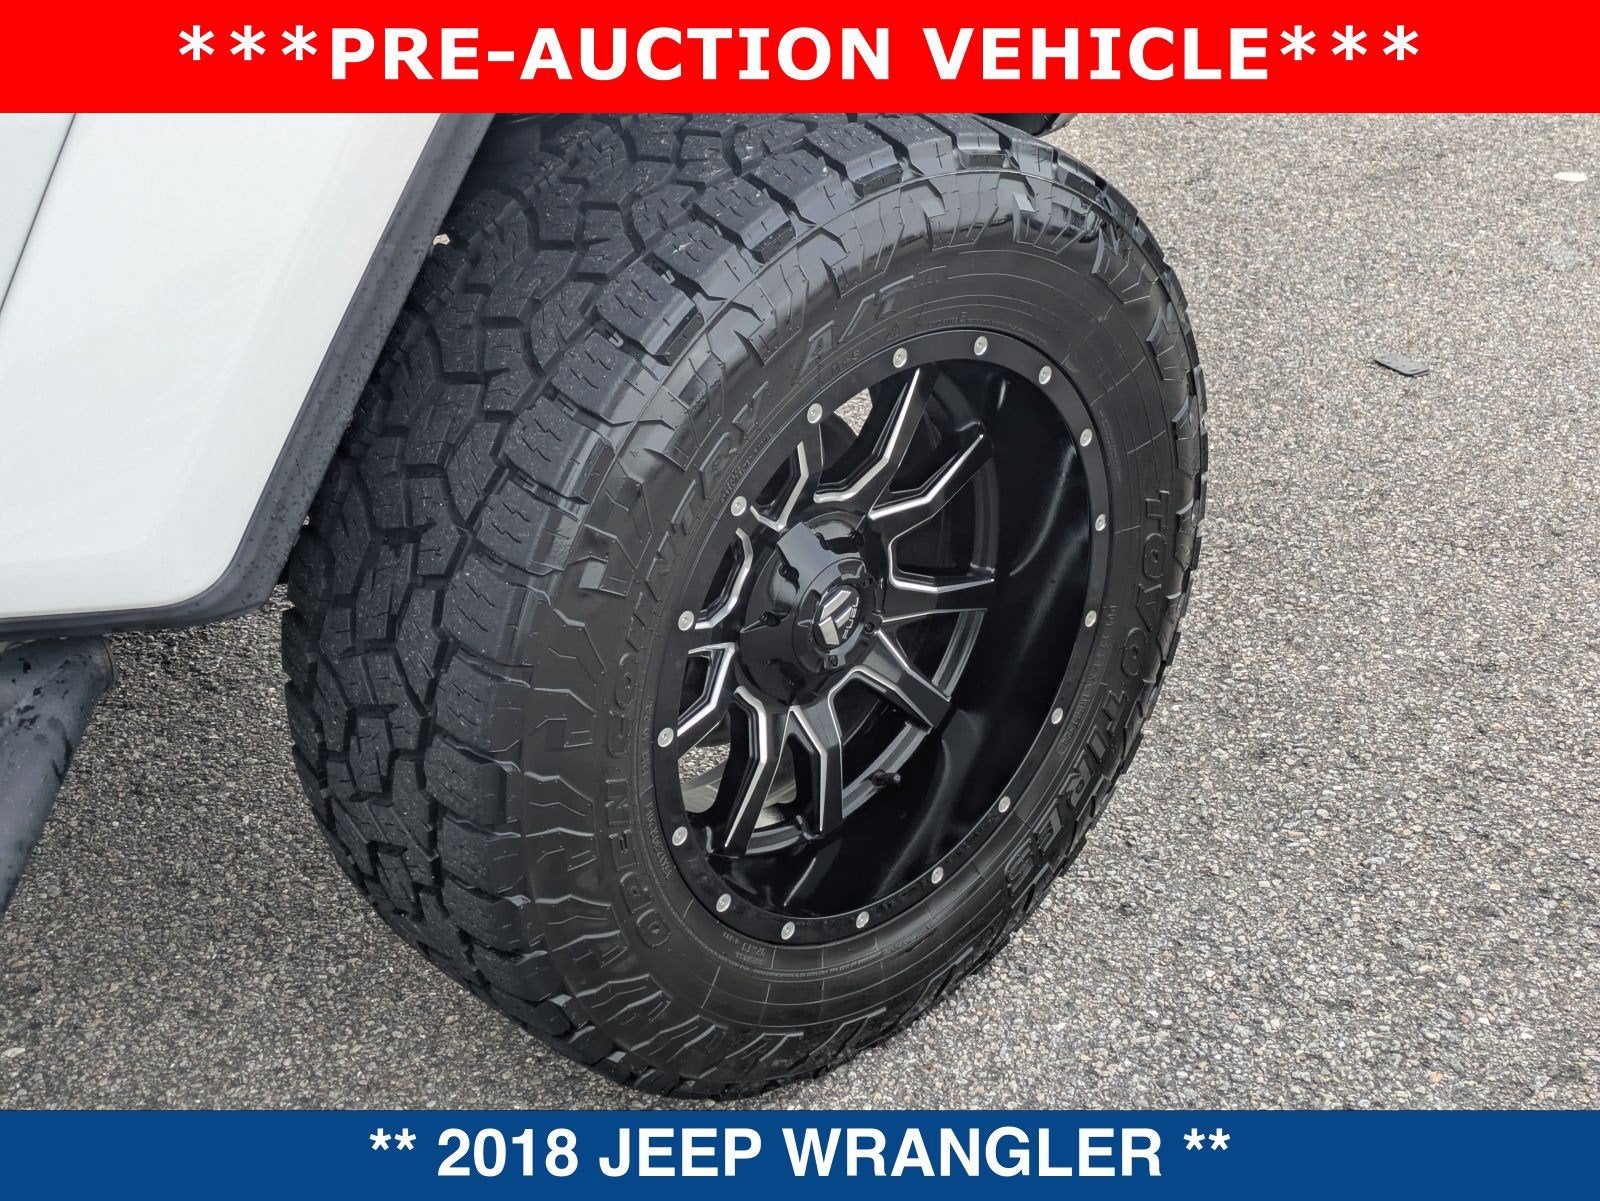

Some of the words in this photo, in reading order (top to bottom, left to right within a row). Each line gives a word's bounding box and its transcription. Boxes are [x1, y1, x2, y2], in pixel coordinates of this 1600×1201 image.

[801, 274, 915, 374] A/T
[606, 380, 770, 761] COUNTRY
[841, 597, 860, 640] FUEL
[1120, 489, 1171, 677] TOYO
[603, 777, 673, 949] OPEN
[1004, 684, 1130, 893] TIRES
